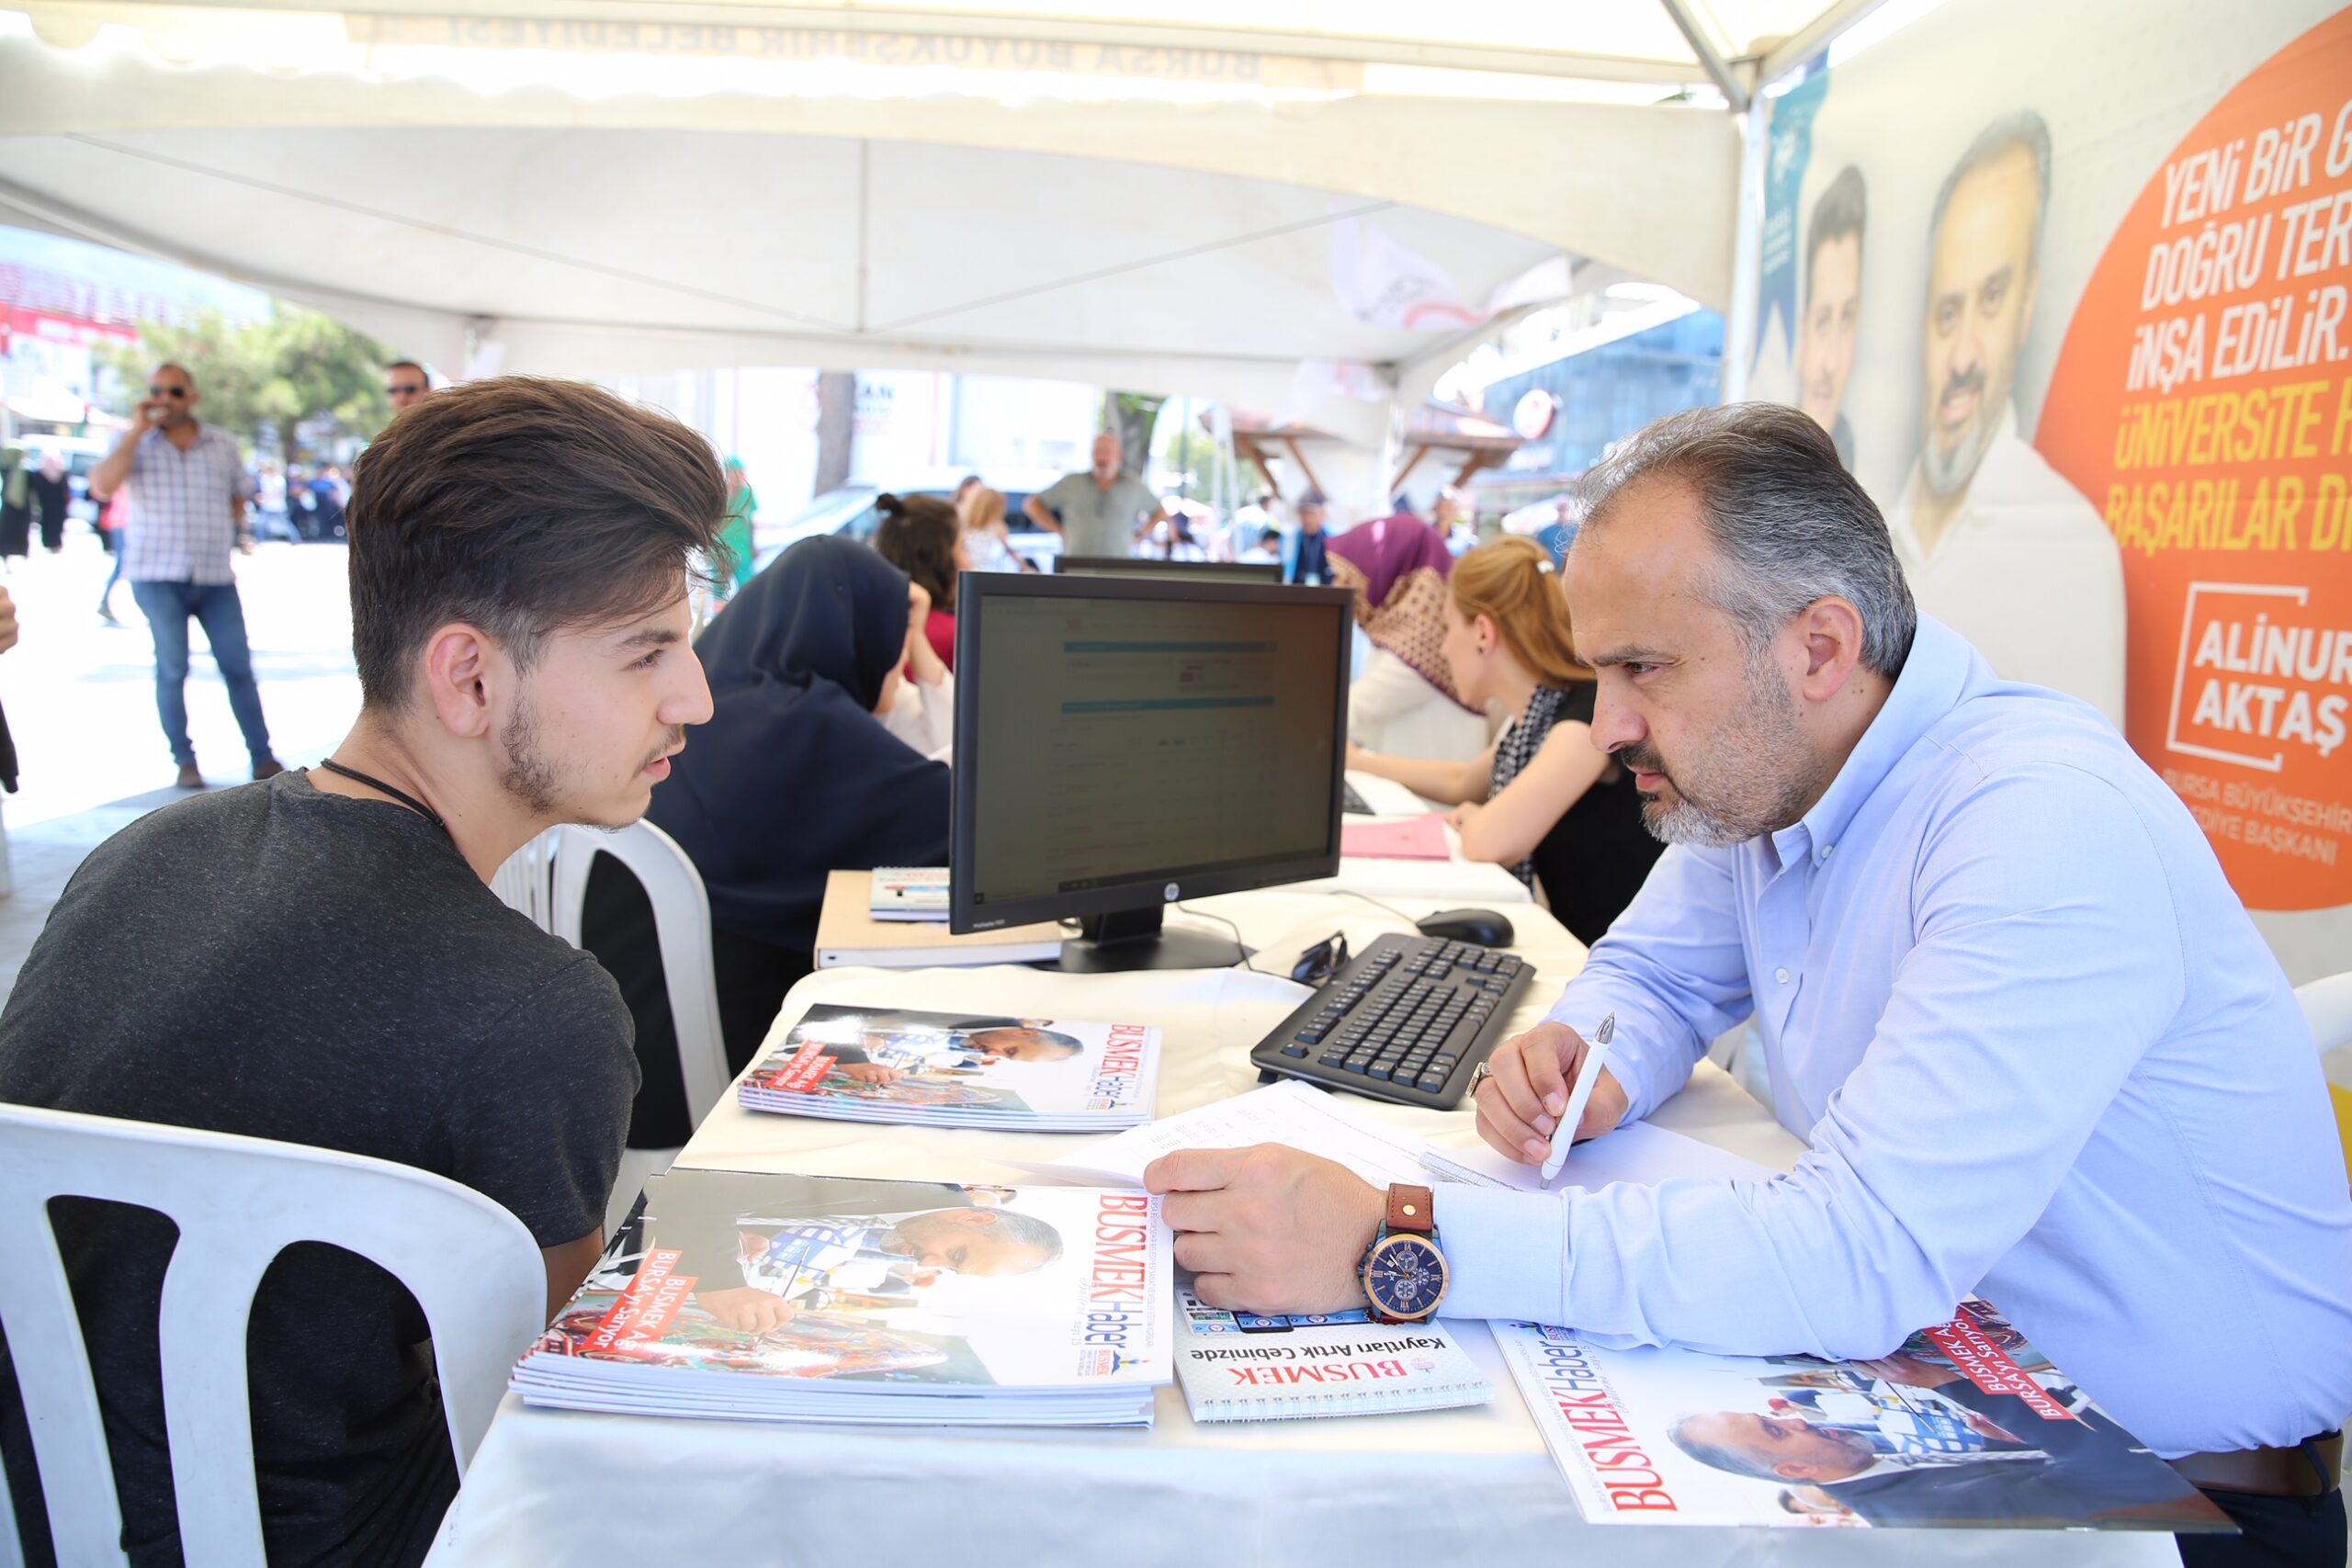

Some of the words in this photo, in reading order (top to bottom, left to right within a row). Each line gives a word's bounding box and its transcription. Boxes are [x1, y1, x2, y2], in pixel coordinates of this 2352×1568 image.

[2161, 139, 2245, 229] YENİ
[2243, 112, 2322, 204] BİR
[2140, 220, 2272, 312] DOĞRU
[2125, 312, 2206, 395] İNŞA
[2211, 284, 2350, 379] EDİLİR.
[2113, 379, 2331, 470] ÜNİVERSİTE
[2105, 475, 2304, 558] BAŞARILAR
[2192, 613, 2352, 685] ALİNUR
[2191, 678, 2350, 759] AKTAŞ
[634, 1277, 687, 1329] BUSMEK
[1191, 1347, 1296, 1361] Cebinizde
[1227, 1359, 1408, 1386] BUSMEK
[1299, 1344, 1351, 1359] Artık
[1356, 1337, 1446, 1356] Kayıtları
[1941, 1339, 2011, 1392] BUSMEK
